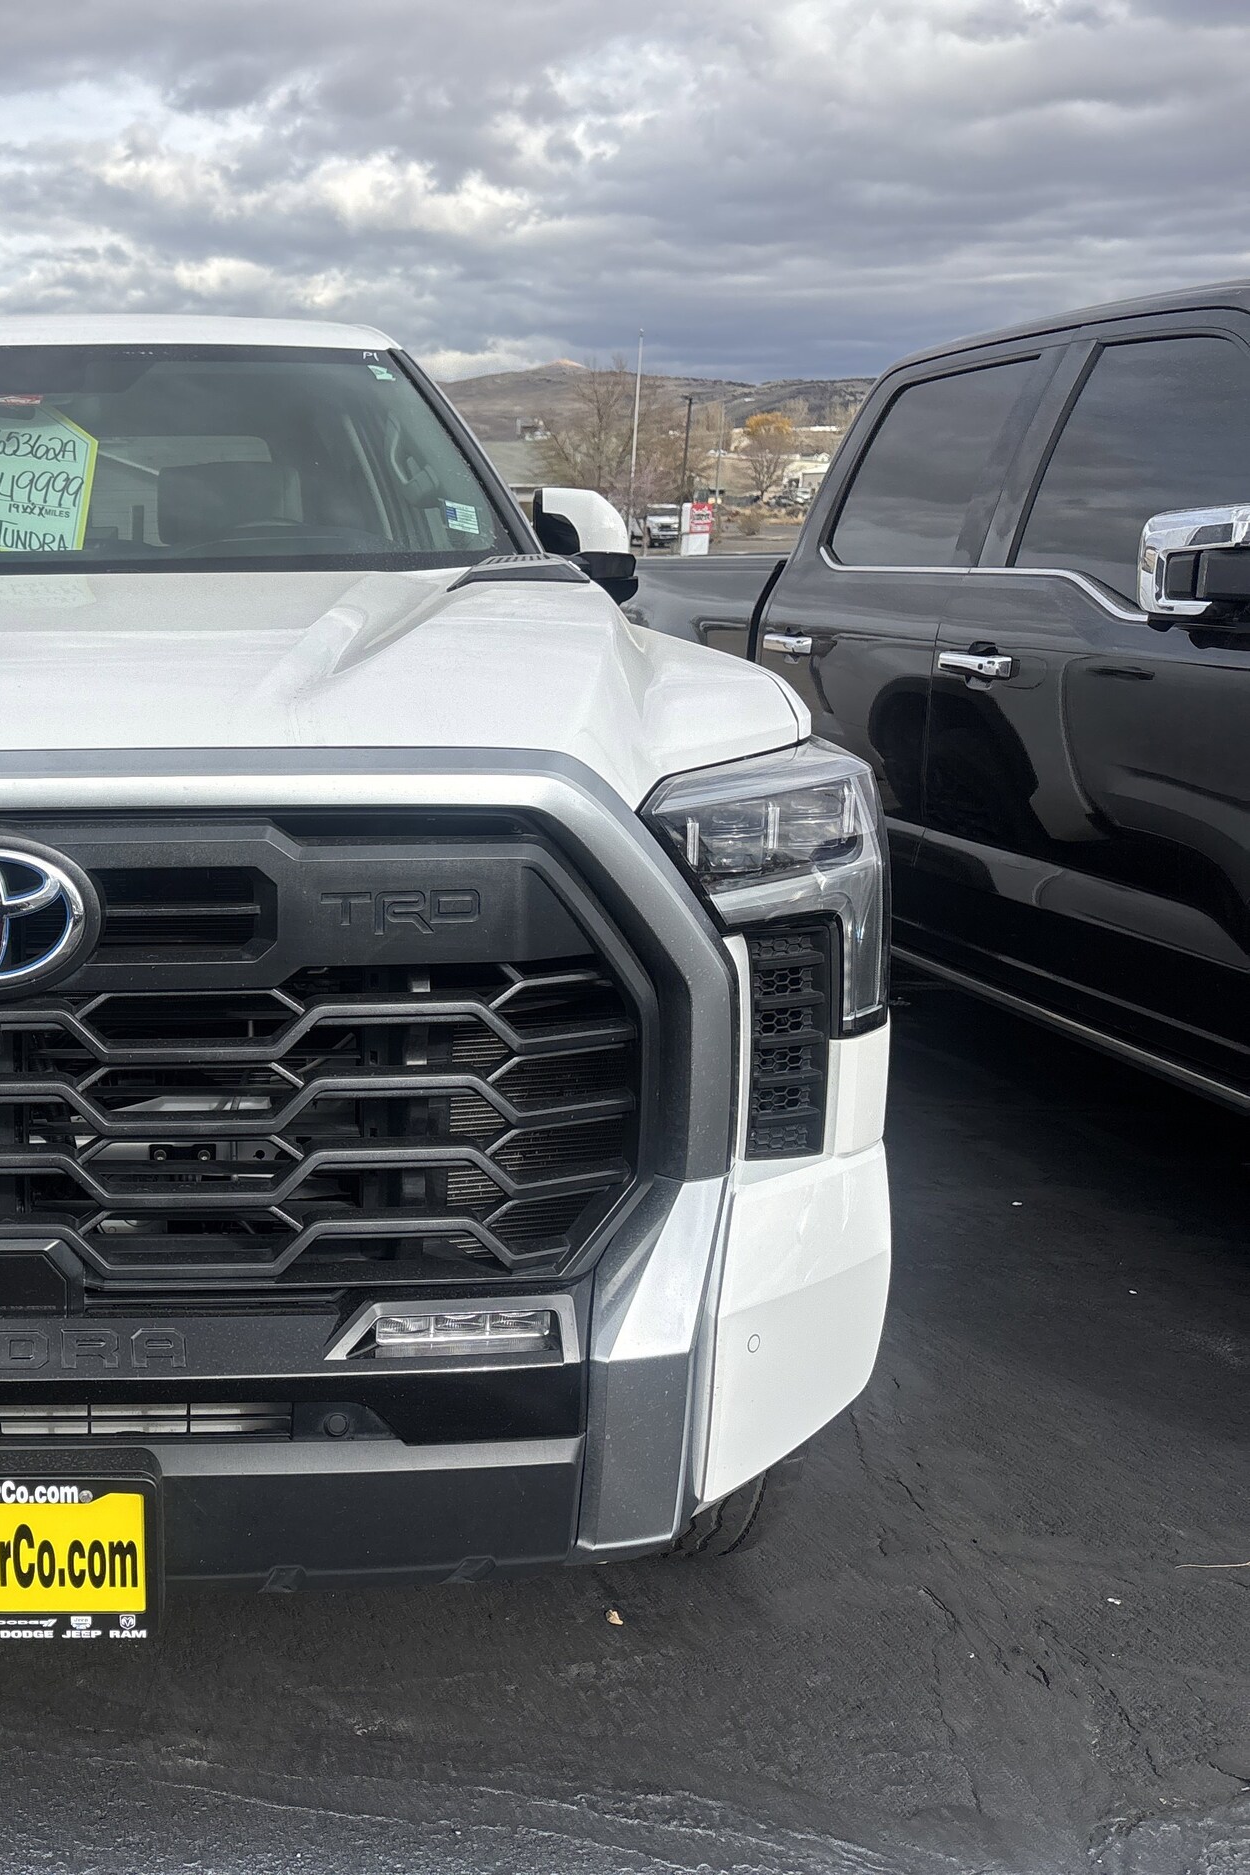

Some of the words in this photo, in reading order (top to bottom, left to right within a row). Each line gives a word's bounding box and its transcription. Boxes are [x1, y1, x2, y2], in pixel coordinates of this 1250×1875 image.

[44, 508, 70, 518] MILES
[321, 889, 481, 936] TRD
[0, 1630, 54, 1639] DODGE
[62, 1630, 102, 1639] JEEP
[109, 1630, 147, 1639] RAM
